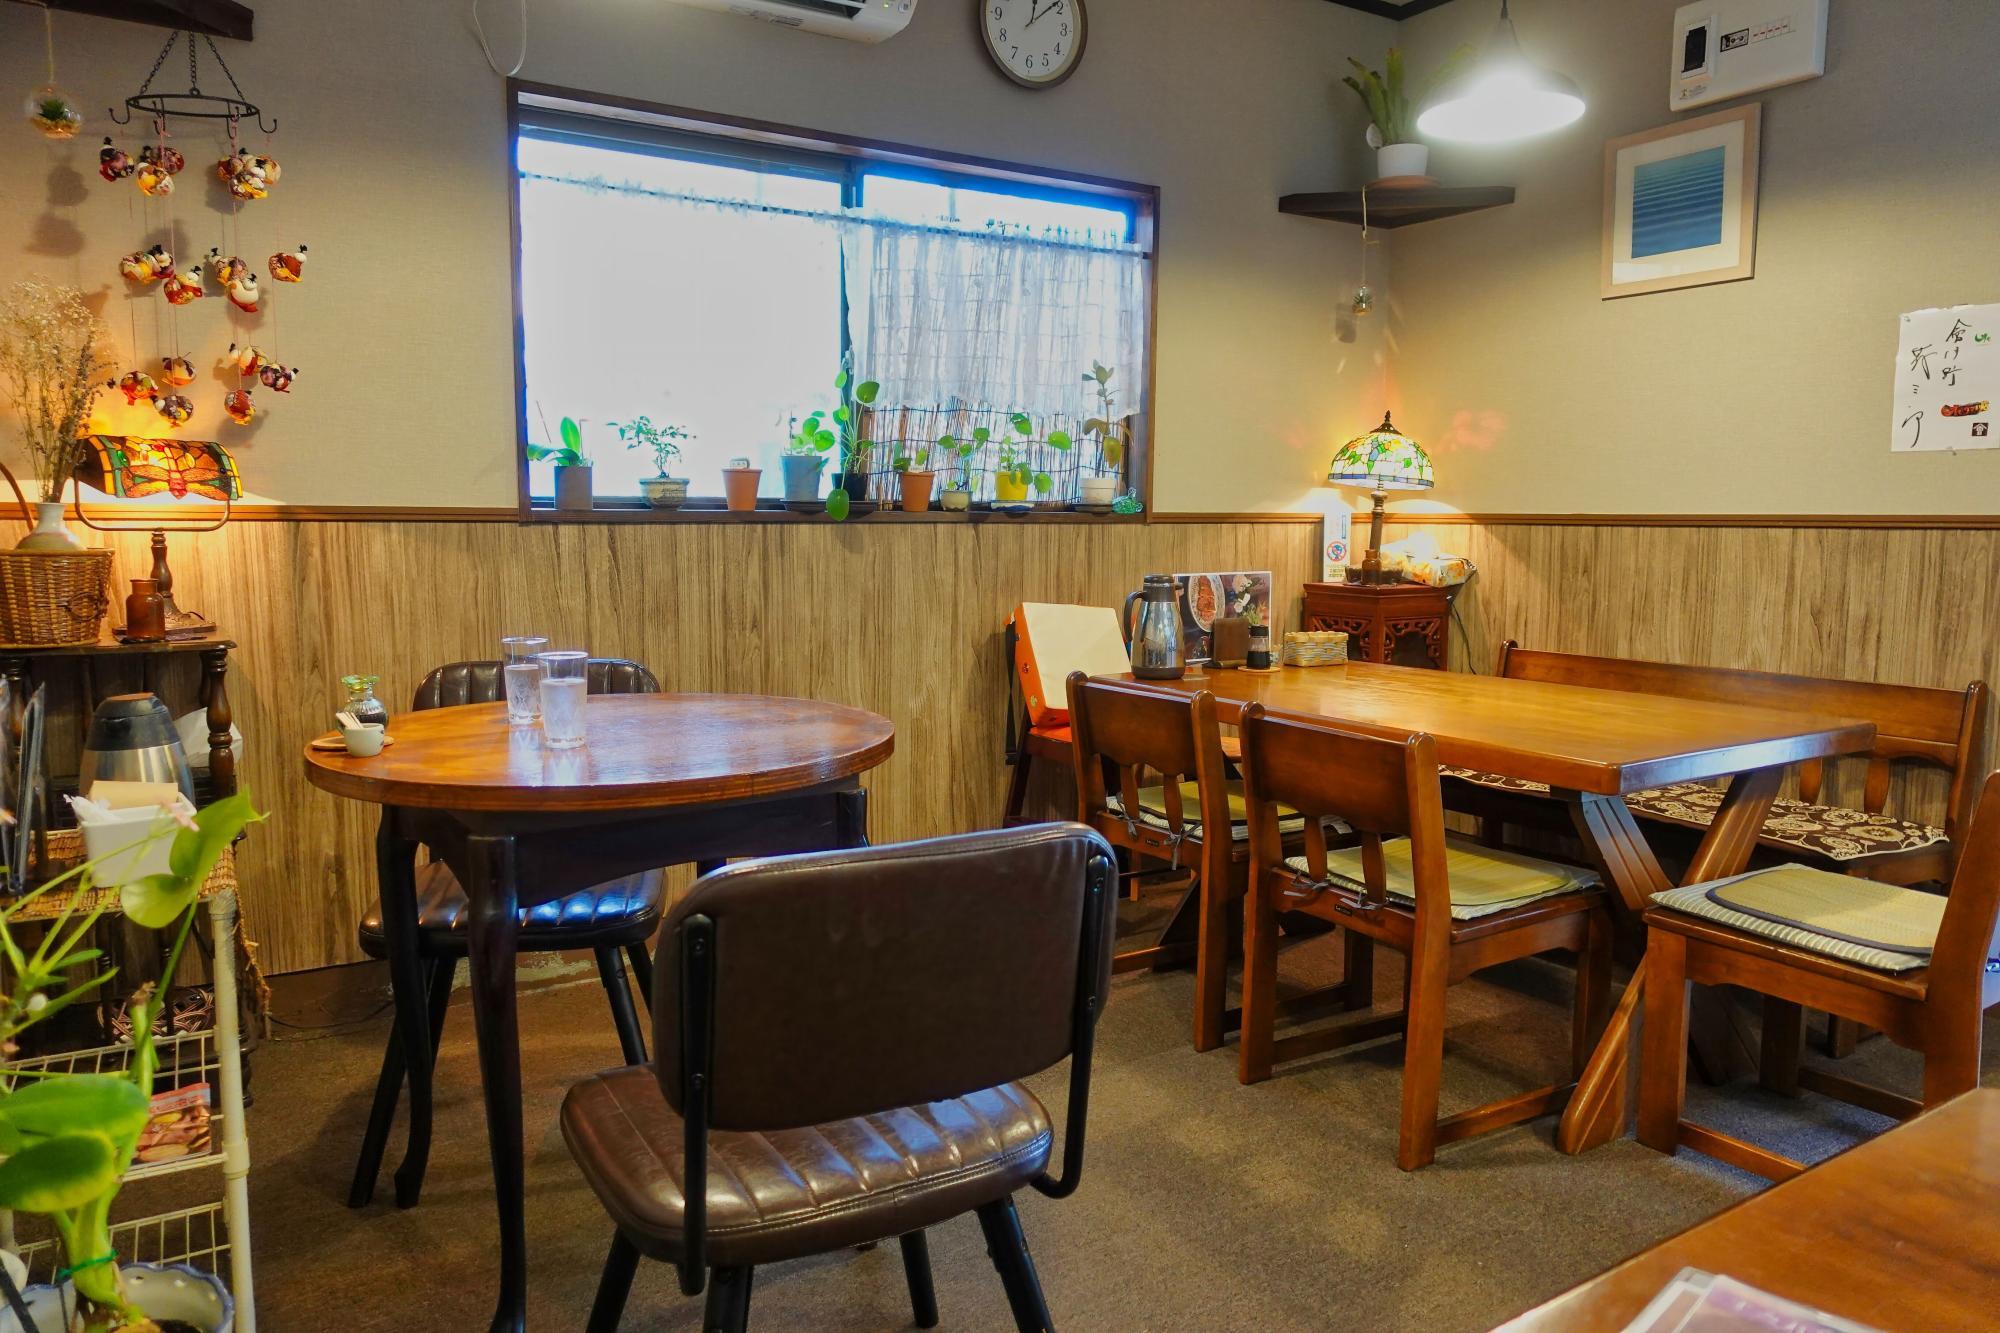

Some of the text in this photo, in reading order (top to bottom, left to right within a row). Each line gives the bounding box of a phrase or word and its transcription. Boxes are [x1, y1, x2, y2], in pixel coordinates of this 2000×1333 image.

[994, 6, 1003, 20] 9
[1056, 1, 1064, 15] 2
[999, 27, 1007, 42] 8
[1060, 22, 1068, 37] 3
[1011, 46, 1019, 60] 7
[1053, 42, 1061, 55] 4
[1025, 54, 1033, 69] 6
[1041, 52, 1049, 67] 5
